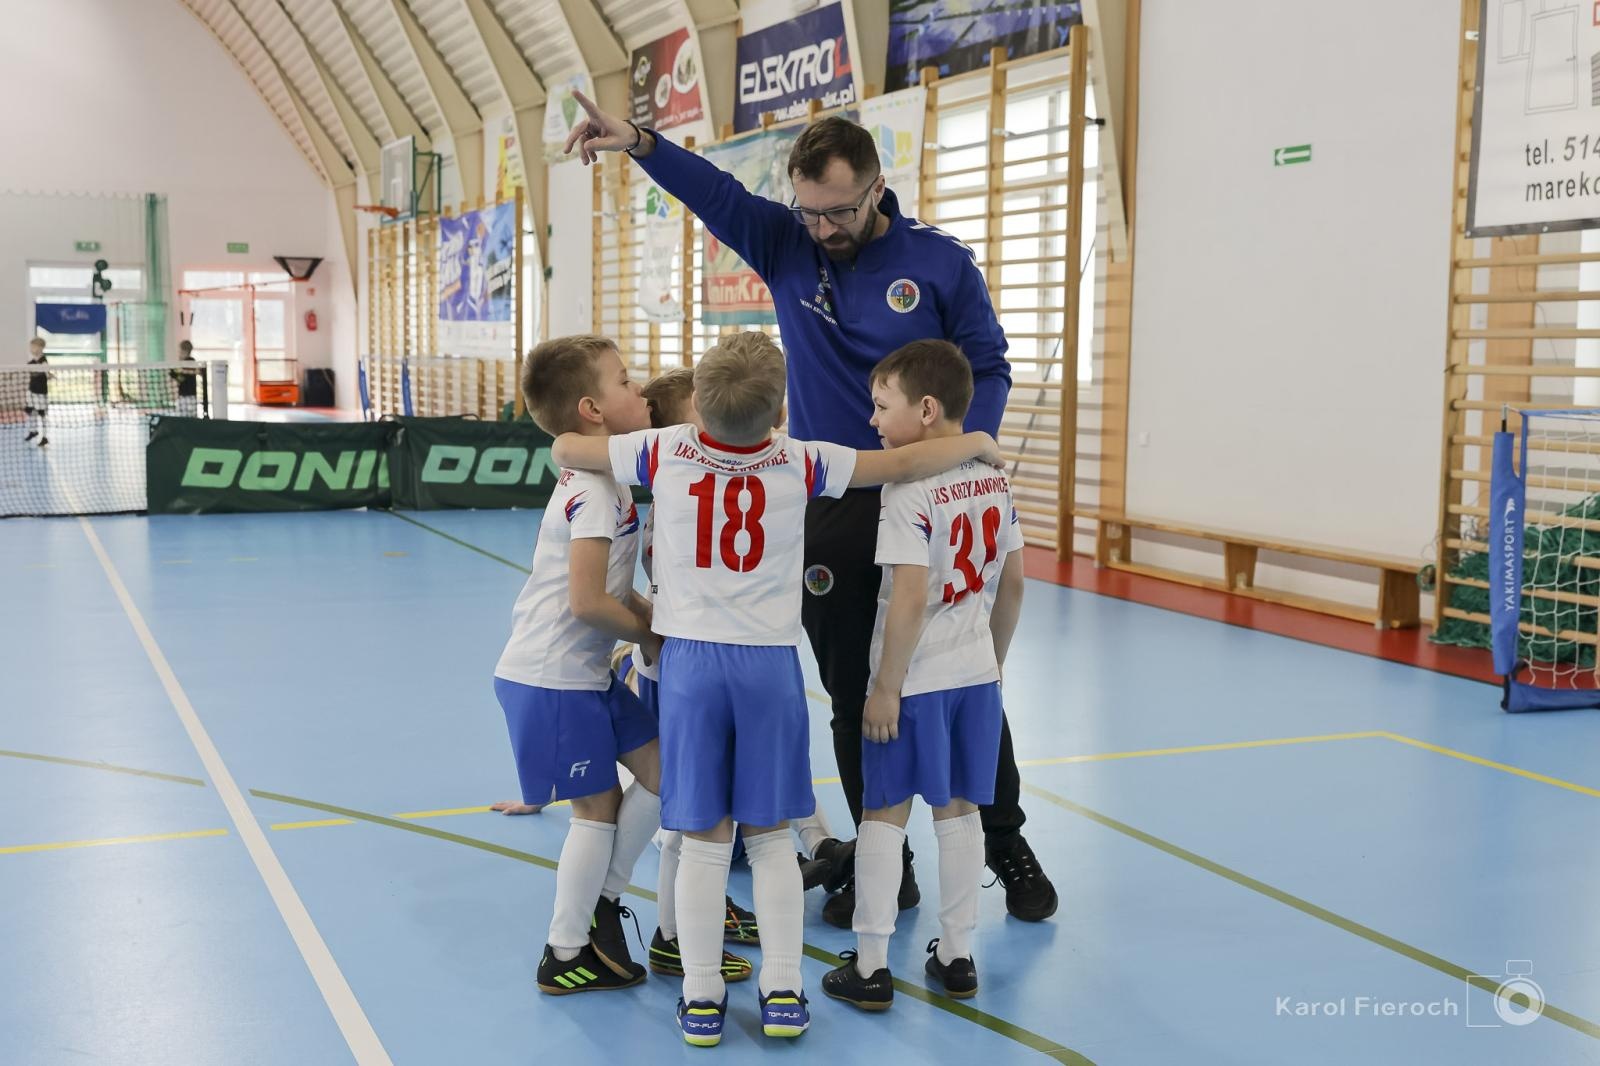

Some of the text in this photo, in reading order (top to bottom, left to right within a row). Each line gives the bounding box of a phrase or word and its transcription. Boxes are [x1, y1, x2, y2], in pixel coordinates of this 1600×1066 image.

[1525, 134, 1600, 166] tel. 514
[688, 472, 766, 573] 18
[1503, 517, 1516, 612] YAKIMASPORT
